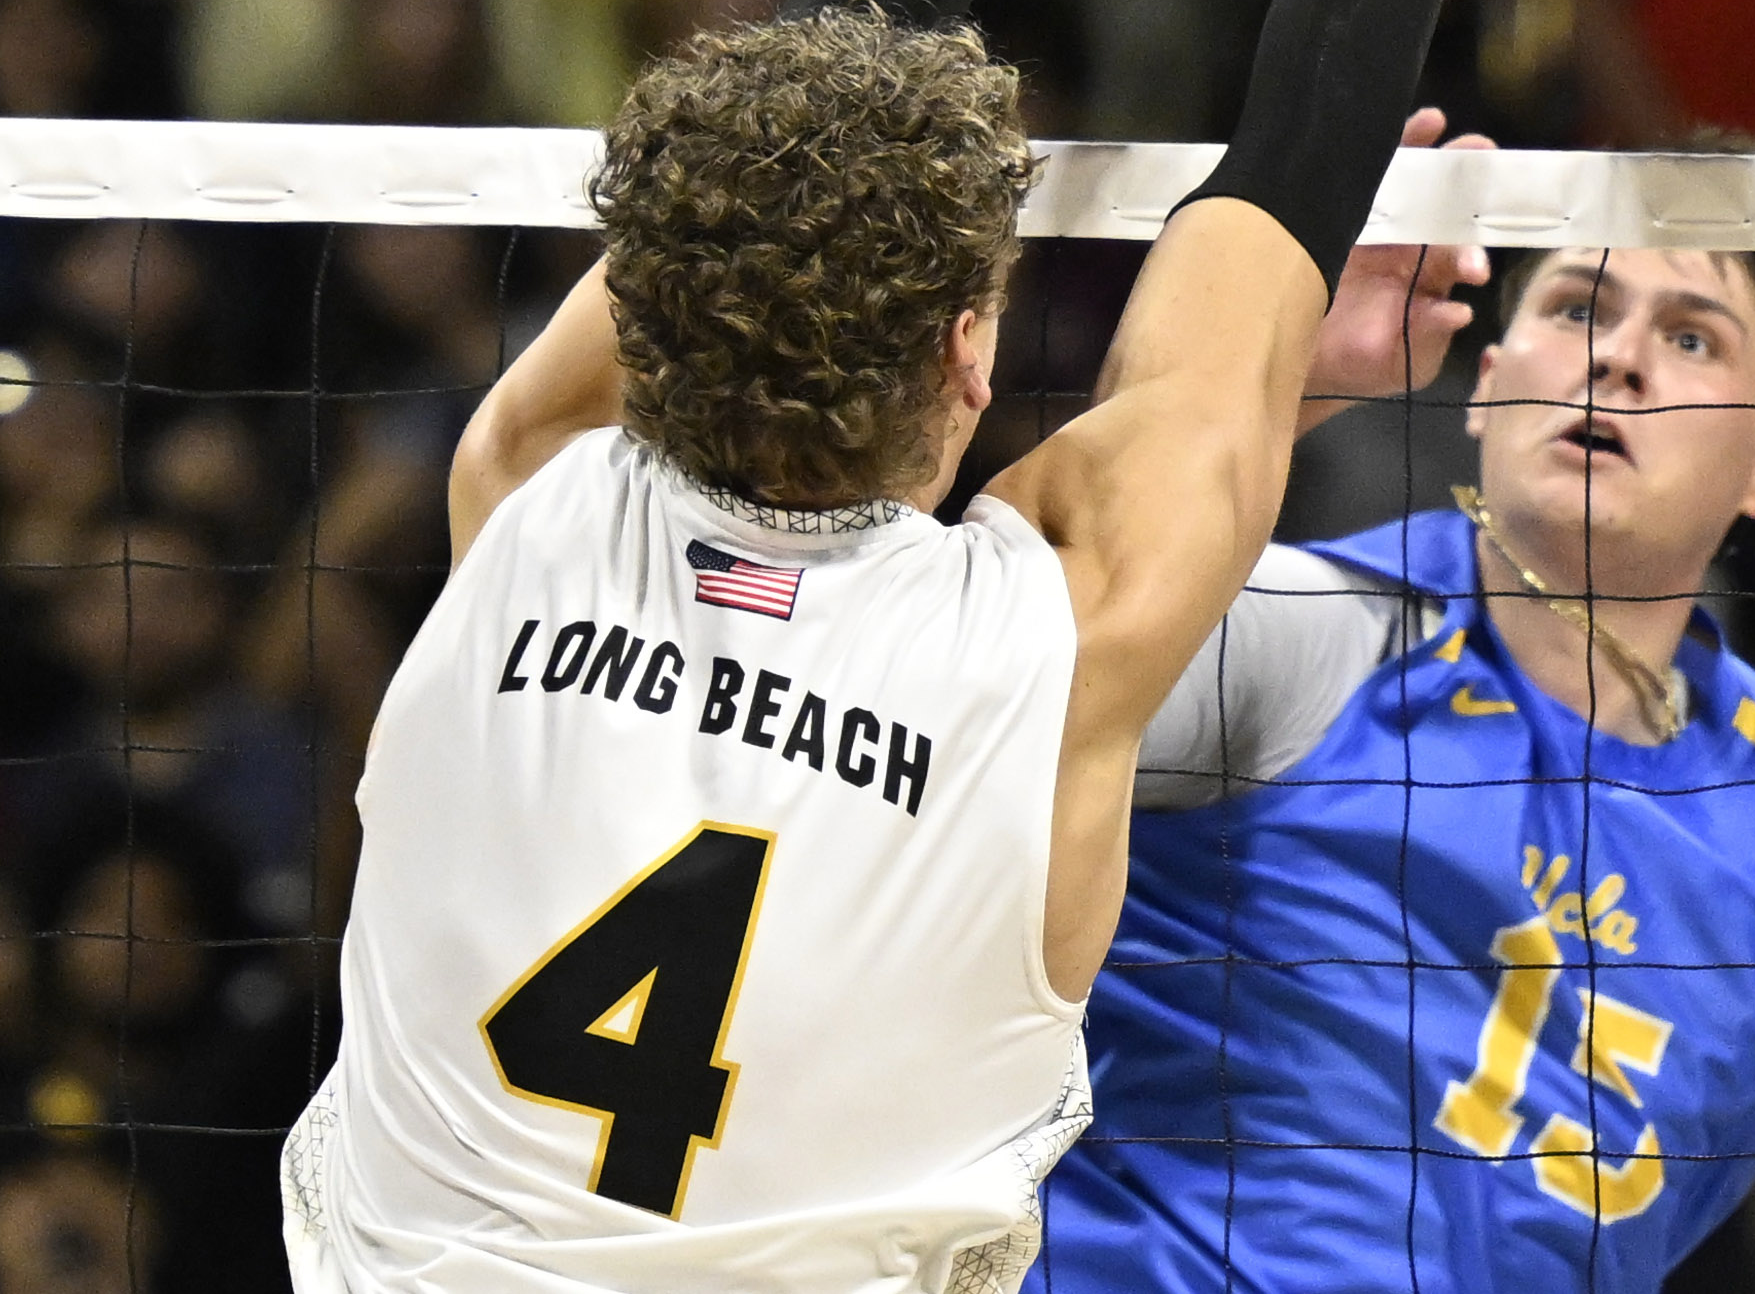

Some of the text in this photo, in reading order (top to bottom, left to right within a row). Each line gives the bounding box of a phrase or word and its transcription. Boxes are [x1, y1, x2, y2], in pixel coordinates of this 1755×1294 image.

[497, 619, 933, 818] LONG BEACH
[477, 819, 778, 1223] 4
[1432, 915, 1675, 1226] 15
